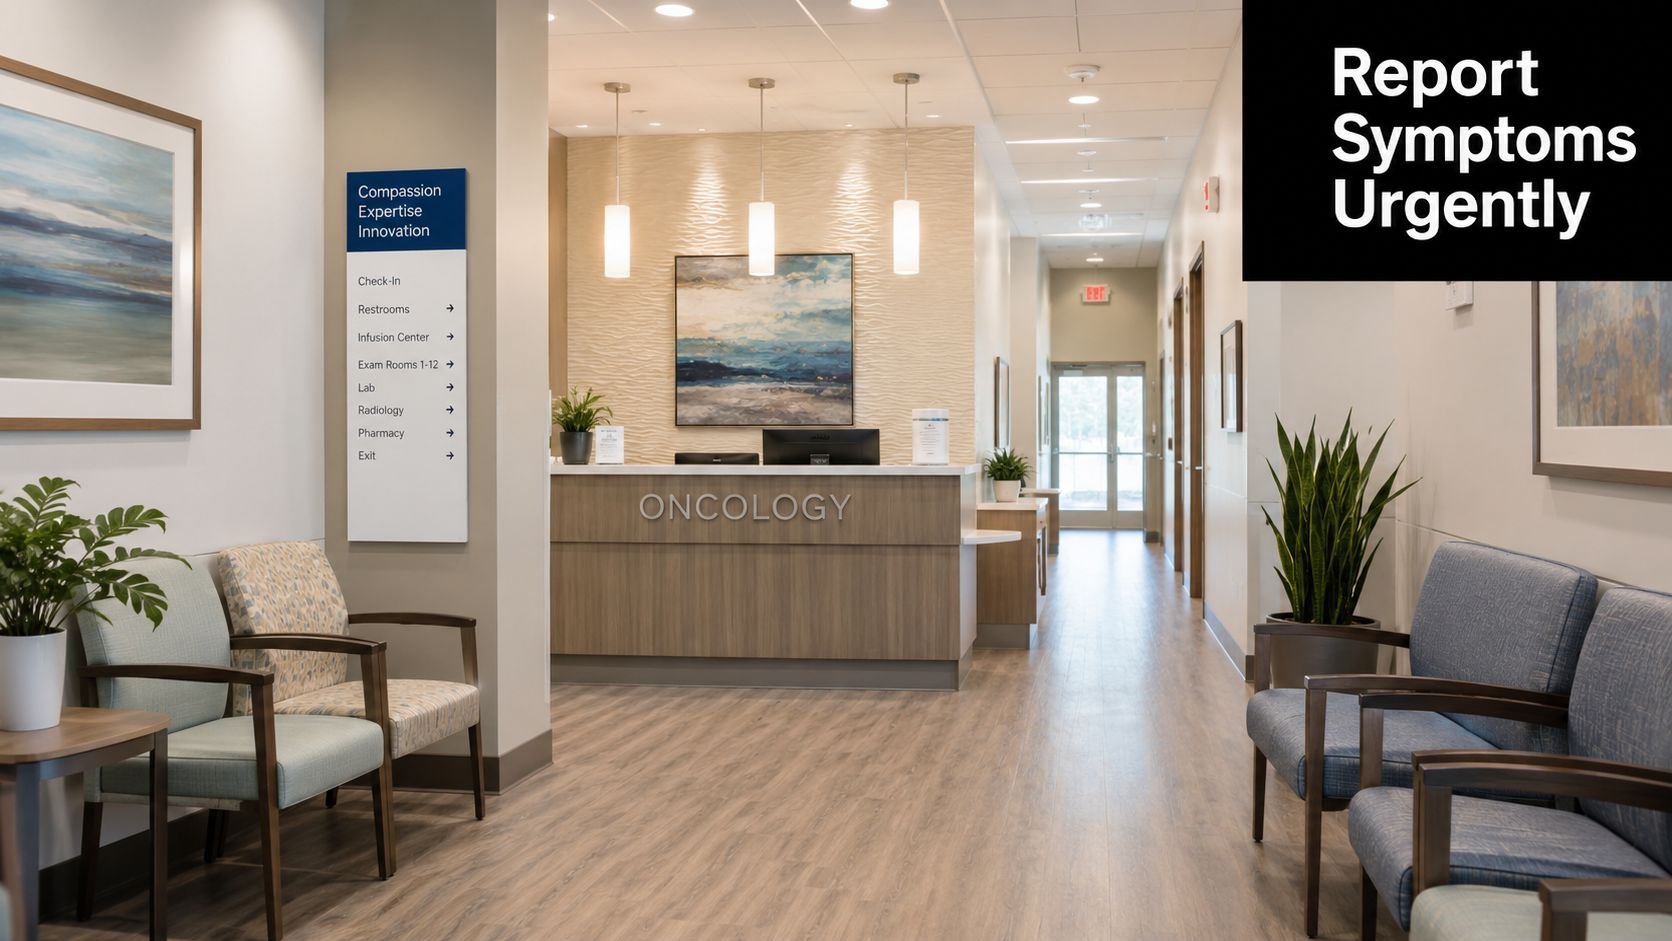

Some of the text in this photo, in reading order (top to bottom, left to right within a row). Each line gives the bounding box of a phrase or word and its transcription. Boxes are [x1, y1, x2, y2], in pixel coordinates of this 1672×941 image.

[359, 184, 441, 200] Compassion
[359, 204, 422, 220] Expertise
[359, 224, 429, 238] Innovation
[358, 276, 400, 286] Check-In
[358, 305, 409, 314] Restrooms
[358, 332, 429, 342] Infusion Center
[358, 360, 438, 369] Exam Rooms 1-12
[358, 383, 375, 392] Lab
[358, 405, 404, 417] Radiology
[358, 428, 404, 440] Pharmacy
[358, 451, 376, 460] Exit
[639, 493, 852, 521] ONCOLOGY
